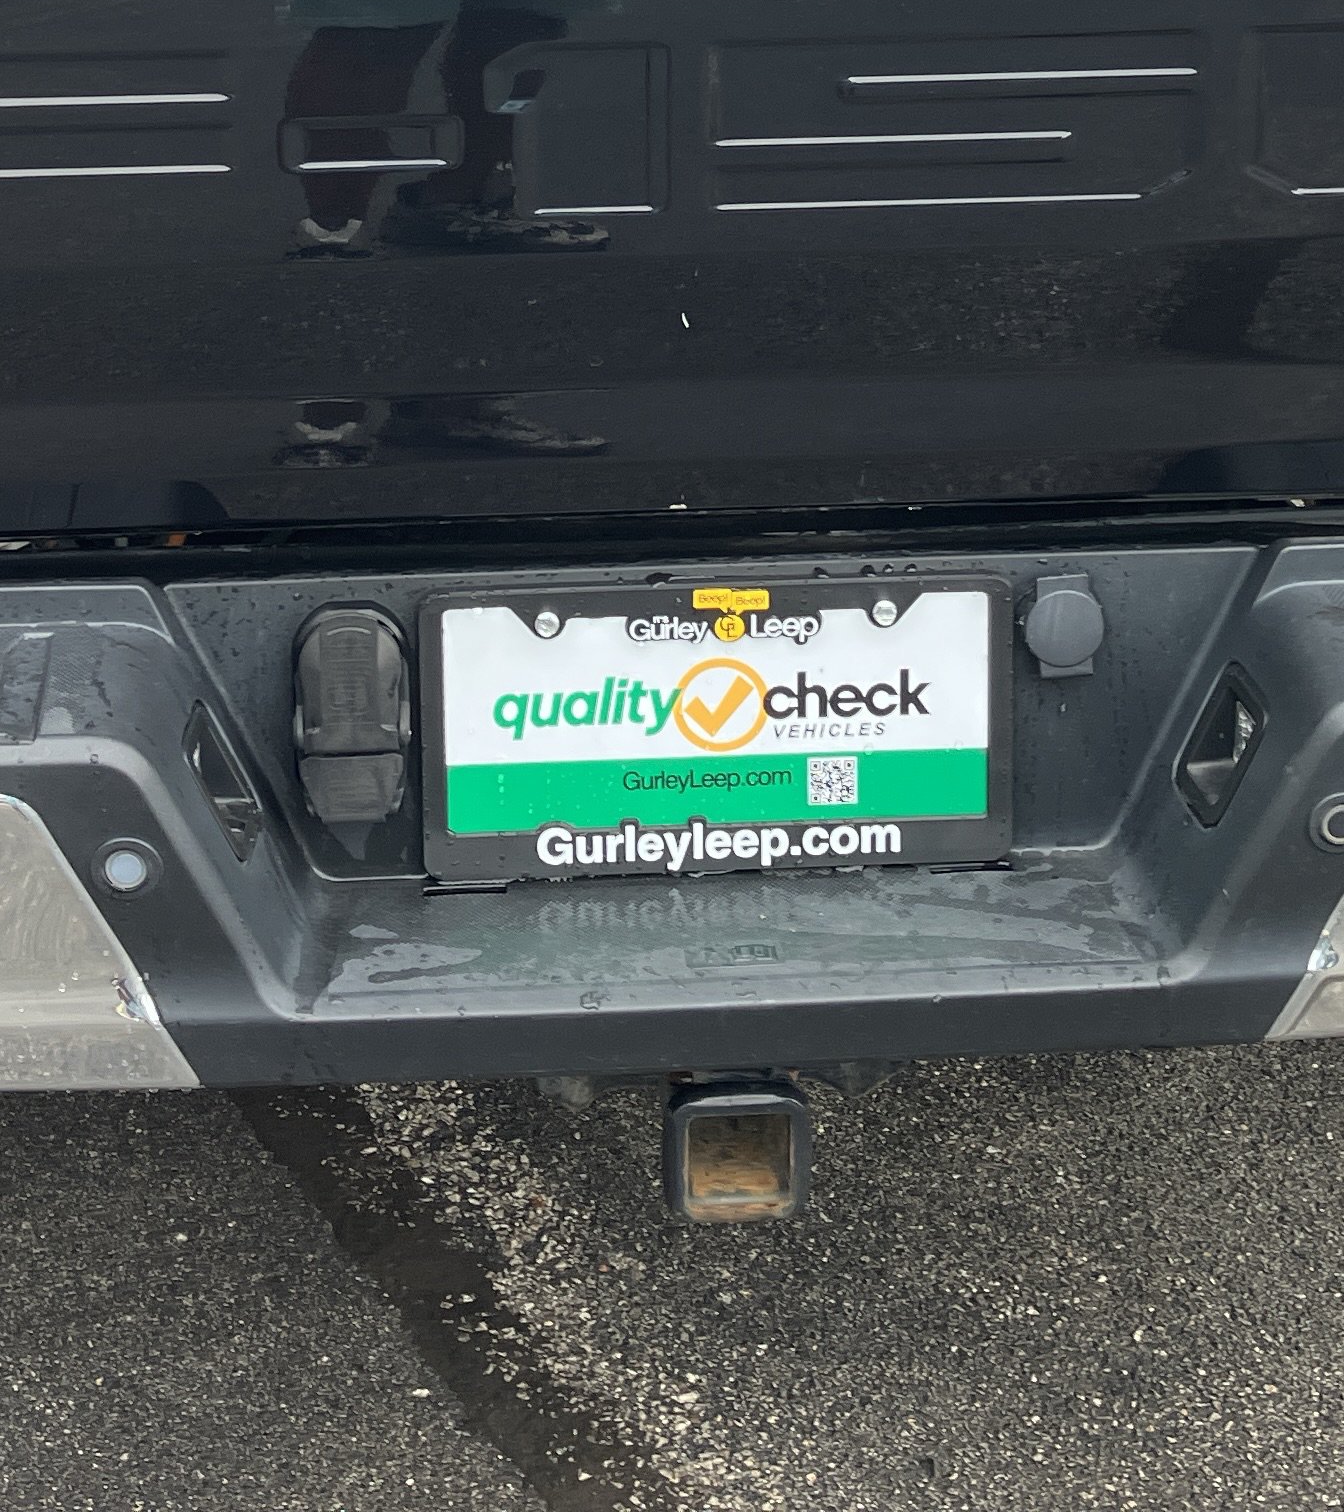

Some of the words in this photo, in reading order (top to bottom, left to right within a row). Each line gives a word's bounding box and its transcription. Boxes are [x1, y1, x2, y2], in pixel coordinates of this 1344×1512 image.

[698, 592, 729, 604] Beep!
[736, 595, 767, 607] Beep!
[628, 615, 709, 644] Gurley
[749, 613, 820, 643] Leep
[493, 676, 684, 741] quality
[762, 668, 932, 720] check
[773, 722, 887, 739] VEHICLES
[623, 768, 792, 795] GurleyLeep.com
[536, 821, 902, 872] Gurleyleep.com
